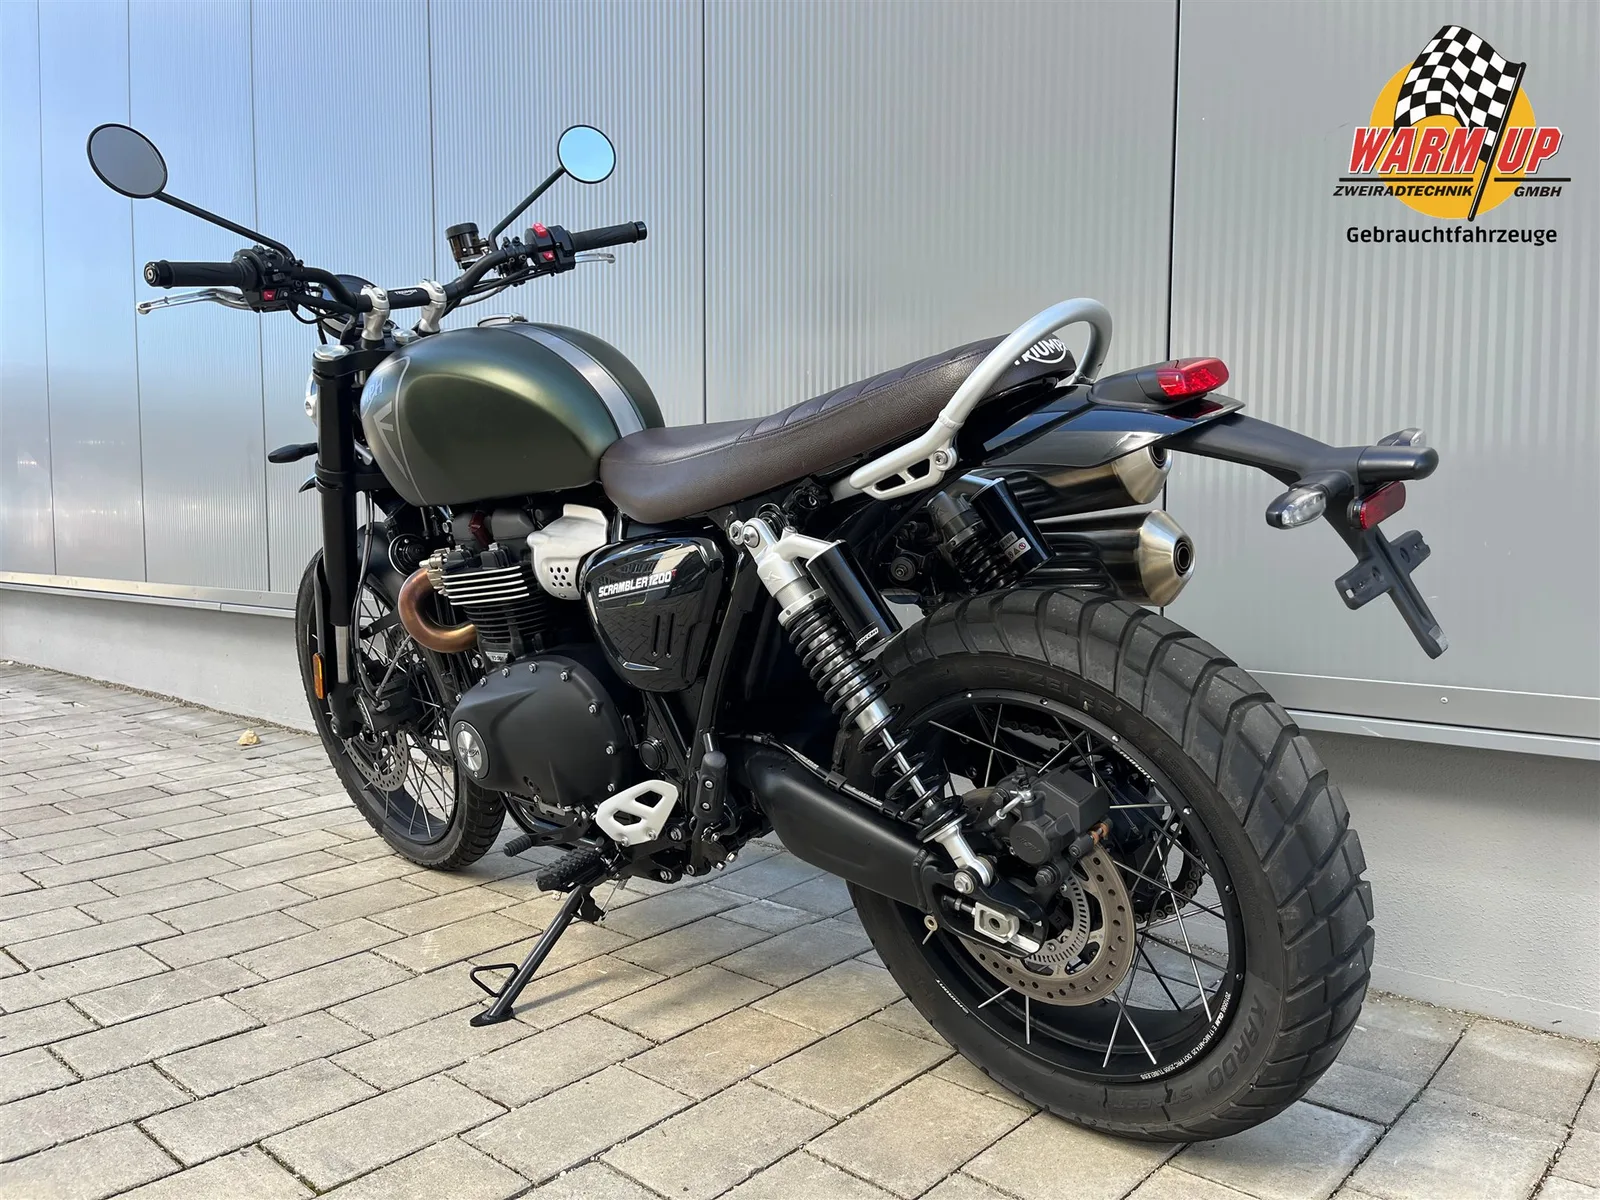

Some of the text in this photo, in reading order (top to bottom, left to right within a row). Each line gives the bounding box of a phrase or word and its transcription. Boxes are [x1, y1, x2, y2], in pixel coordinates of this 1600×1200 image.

[598, 576, 648, 597] SCRAMBLER
[1207, 994, 1267, 1092] KAROO
[1182, 1053, 1192, 1062] DOT
